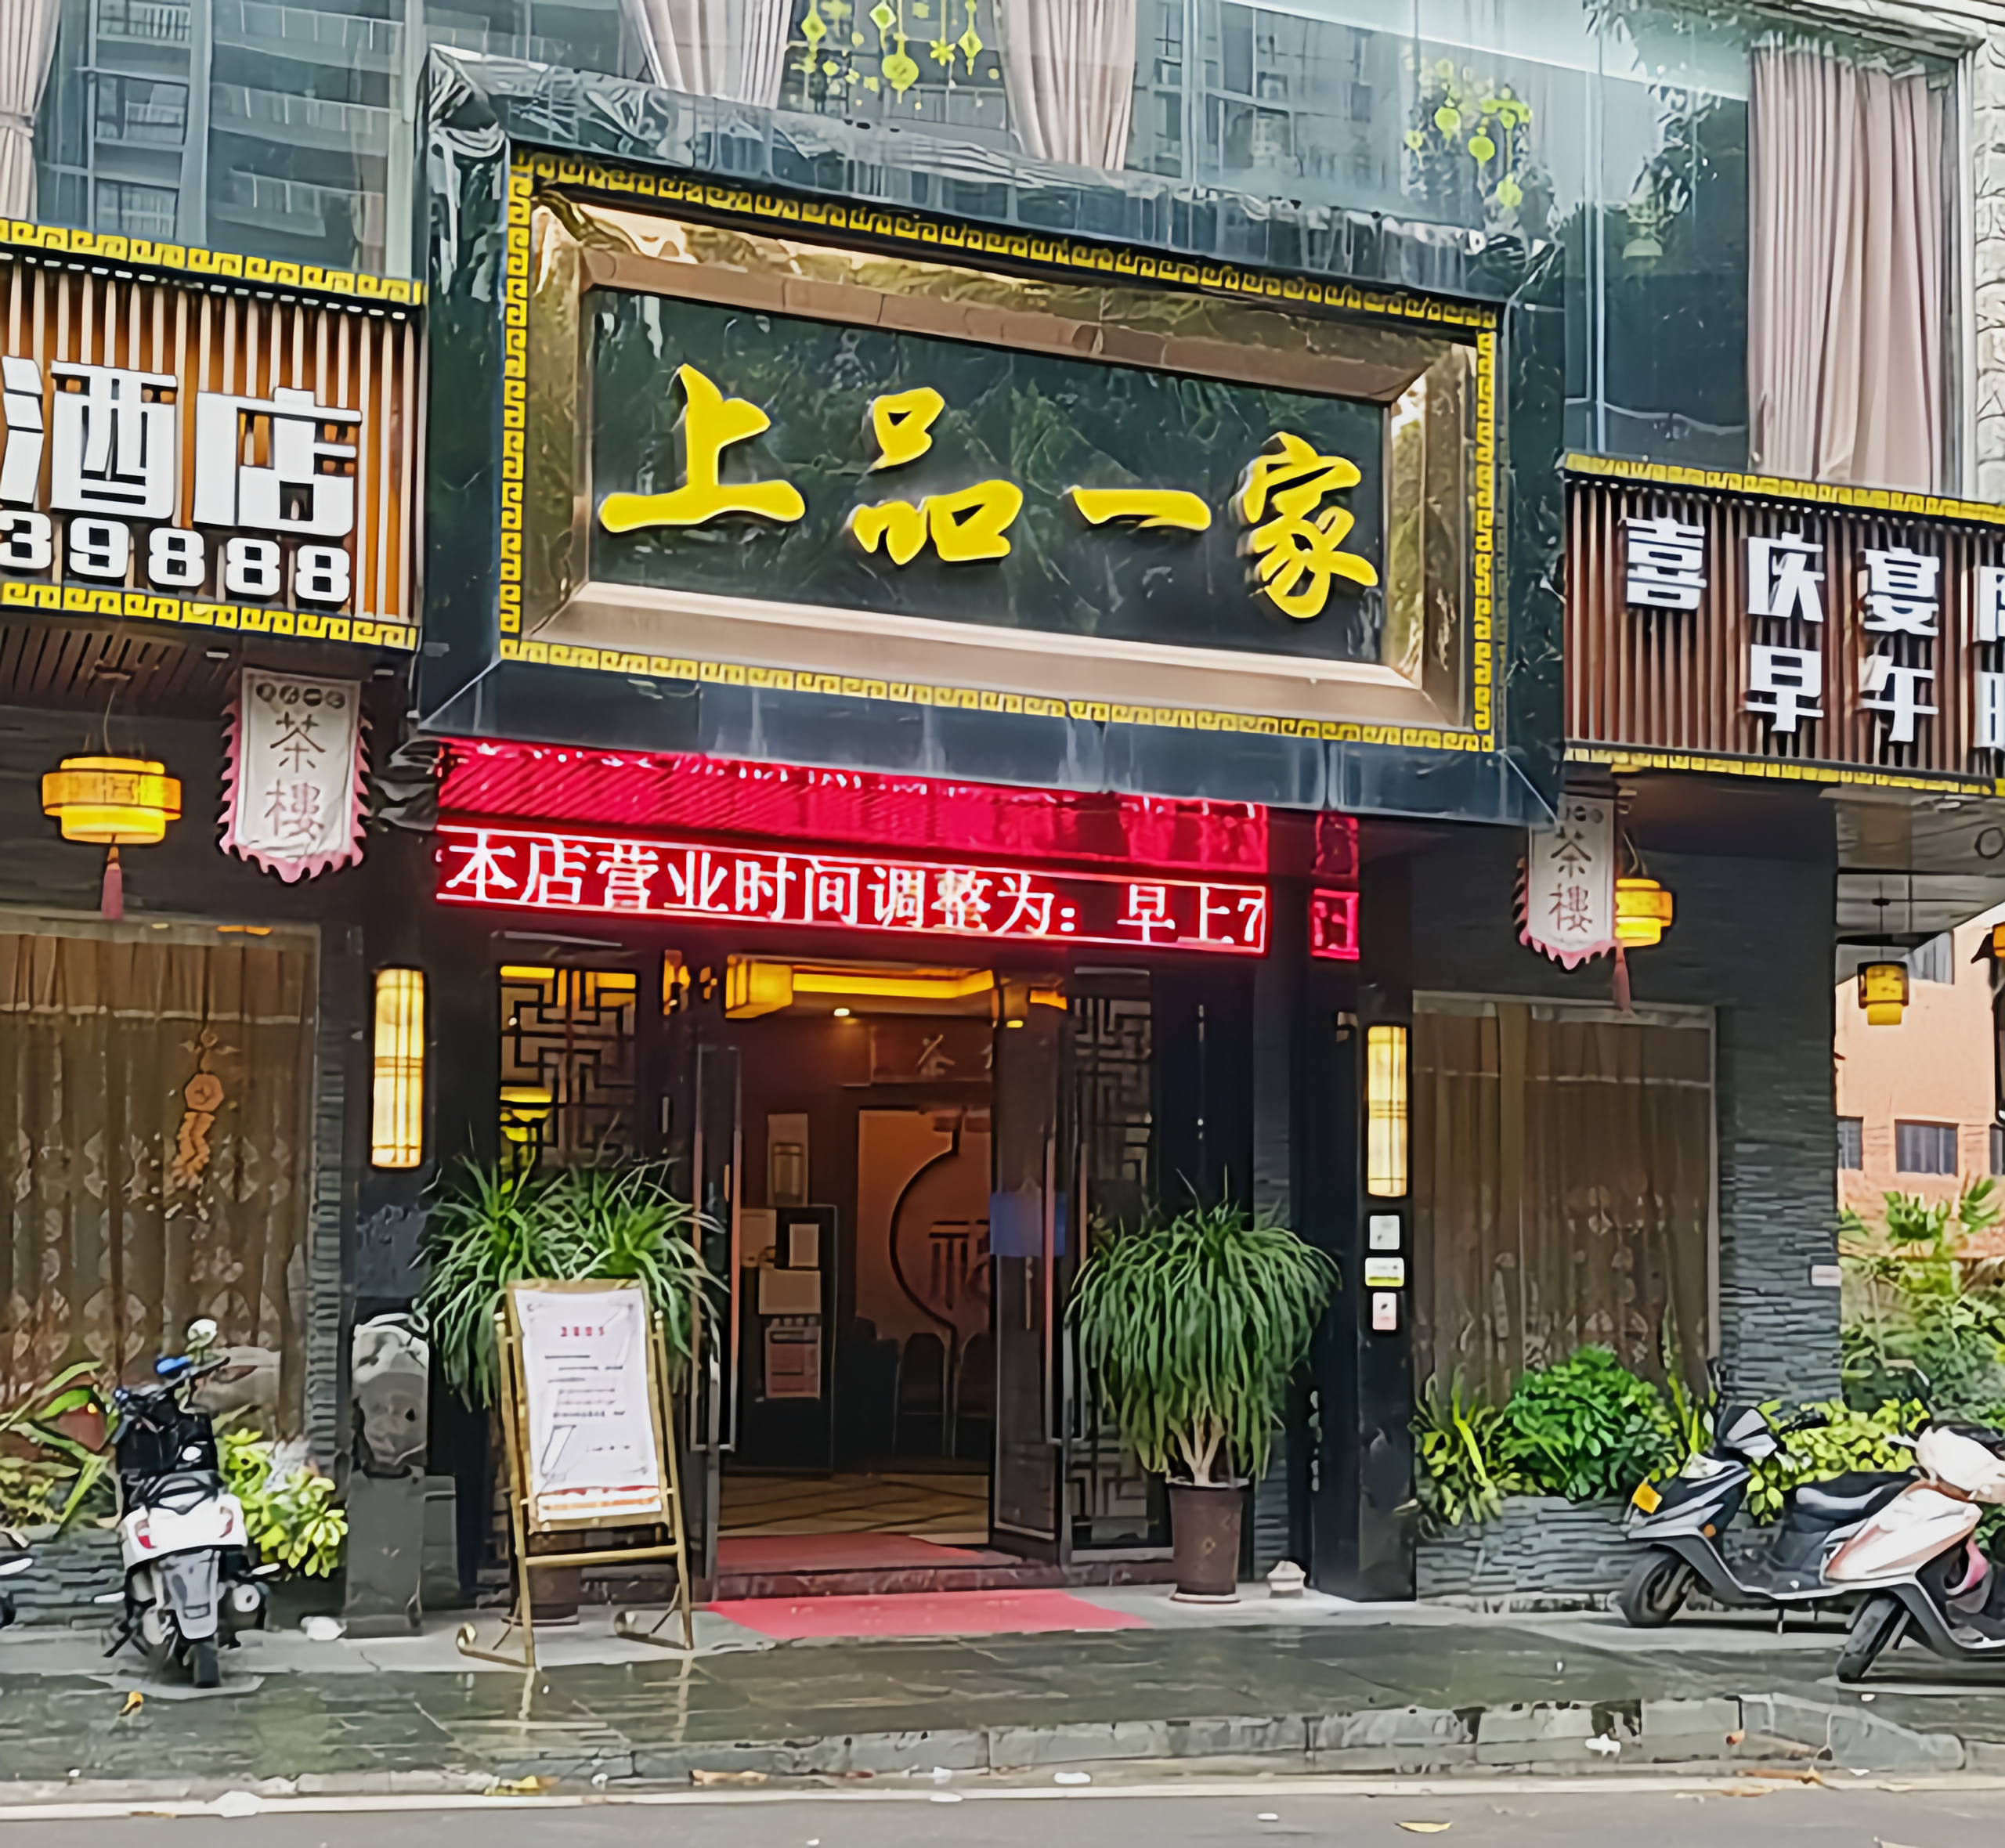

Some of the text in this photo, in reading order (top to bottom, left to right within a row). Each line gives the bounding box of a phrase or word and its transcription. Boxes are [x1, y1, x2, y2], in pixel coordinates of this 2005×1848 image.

[2, 356, 363, 537] 酒店
[599, 363, 1379, 619] 上品一家
[0, 510, 351, 602] 39888
